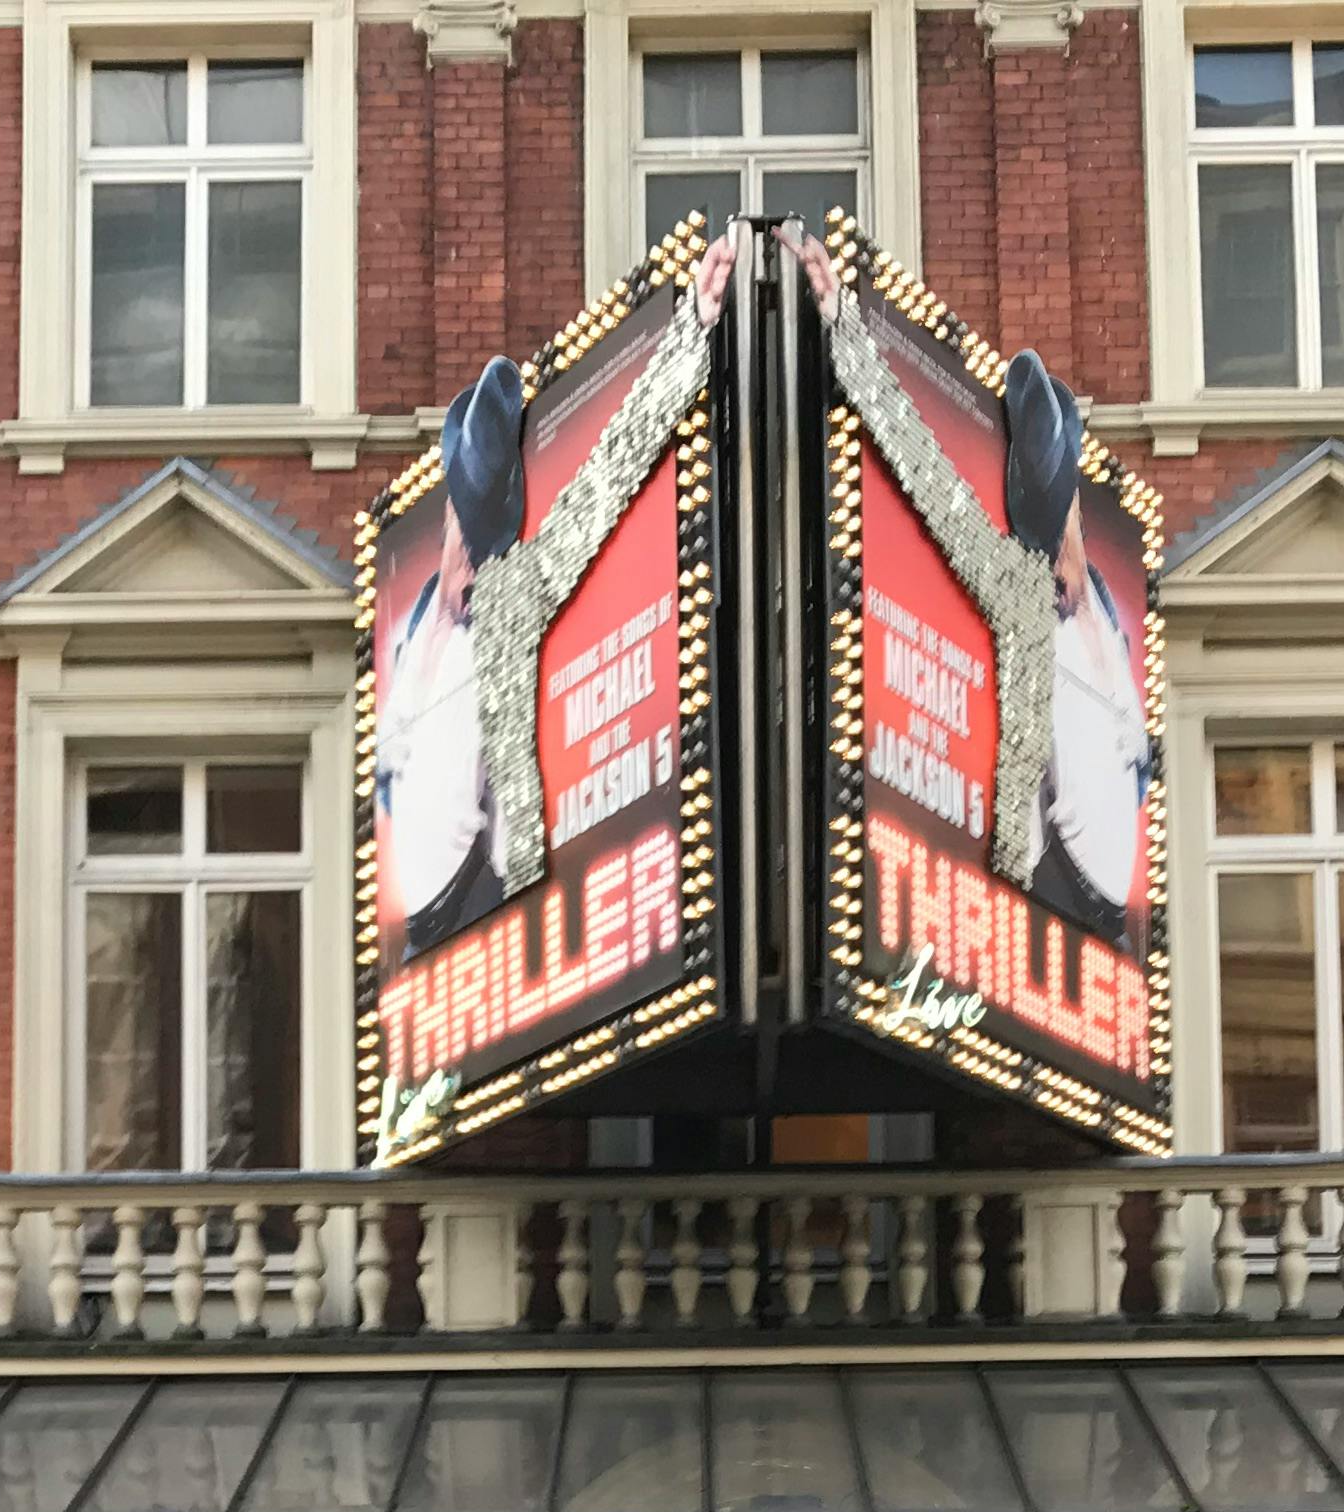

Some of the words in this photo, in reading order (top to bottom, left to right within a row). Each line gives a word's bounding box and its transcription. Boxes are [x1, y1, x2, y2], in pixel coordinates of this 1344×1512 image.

[601, 628, 622, 664] THE
[659, 591, 672, 627] OF
[920, 622, 939, 660] THE
[973, 659, 986, 690] OF
[564, 639, 656, 750] MICHAEL
[884, 630, 970, 740] MICHAEL
[551, 736, 651, 850] JACKSON
[656, 723, 673, 787] 5
[868, 720, 965, 829] JACKSON
[968, 780, 984, 839] 5
[378, 829, 677, 1081] THRILLER
[867, 816, 1150, 1083] THRILLER
[882, 942, 987, 1032] Live
